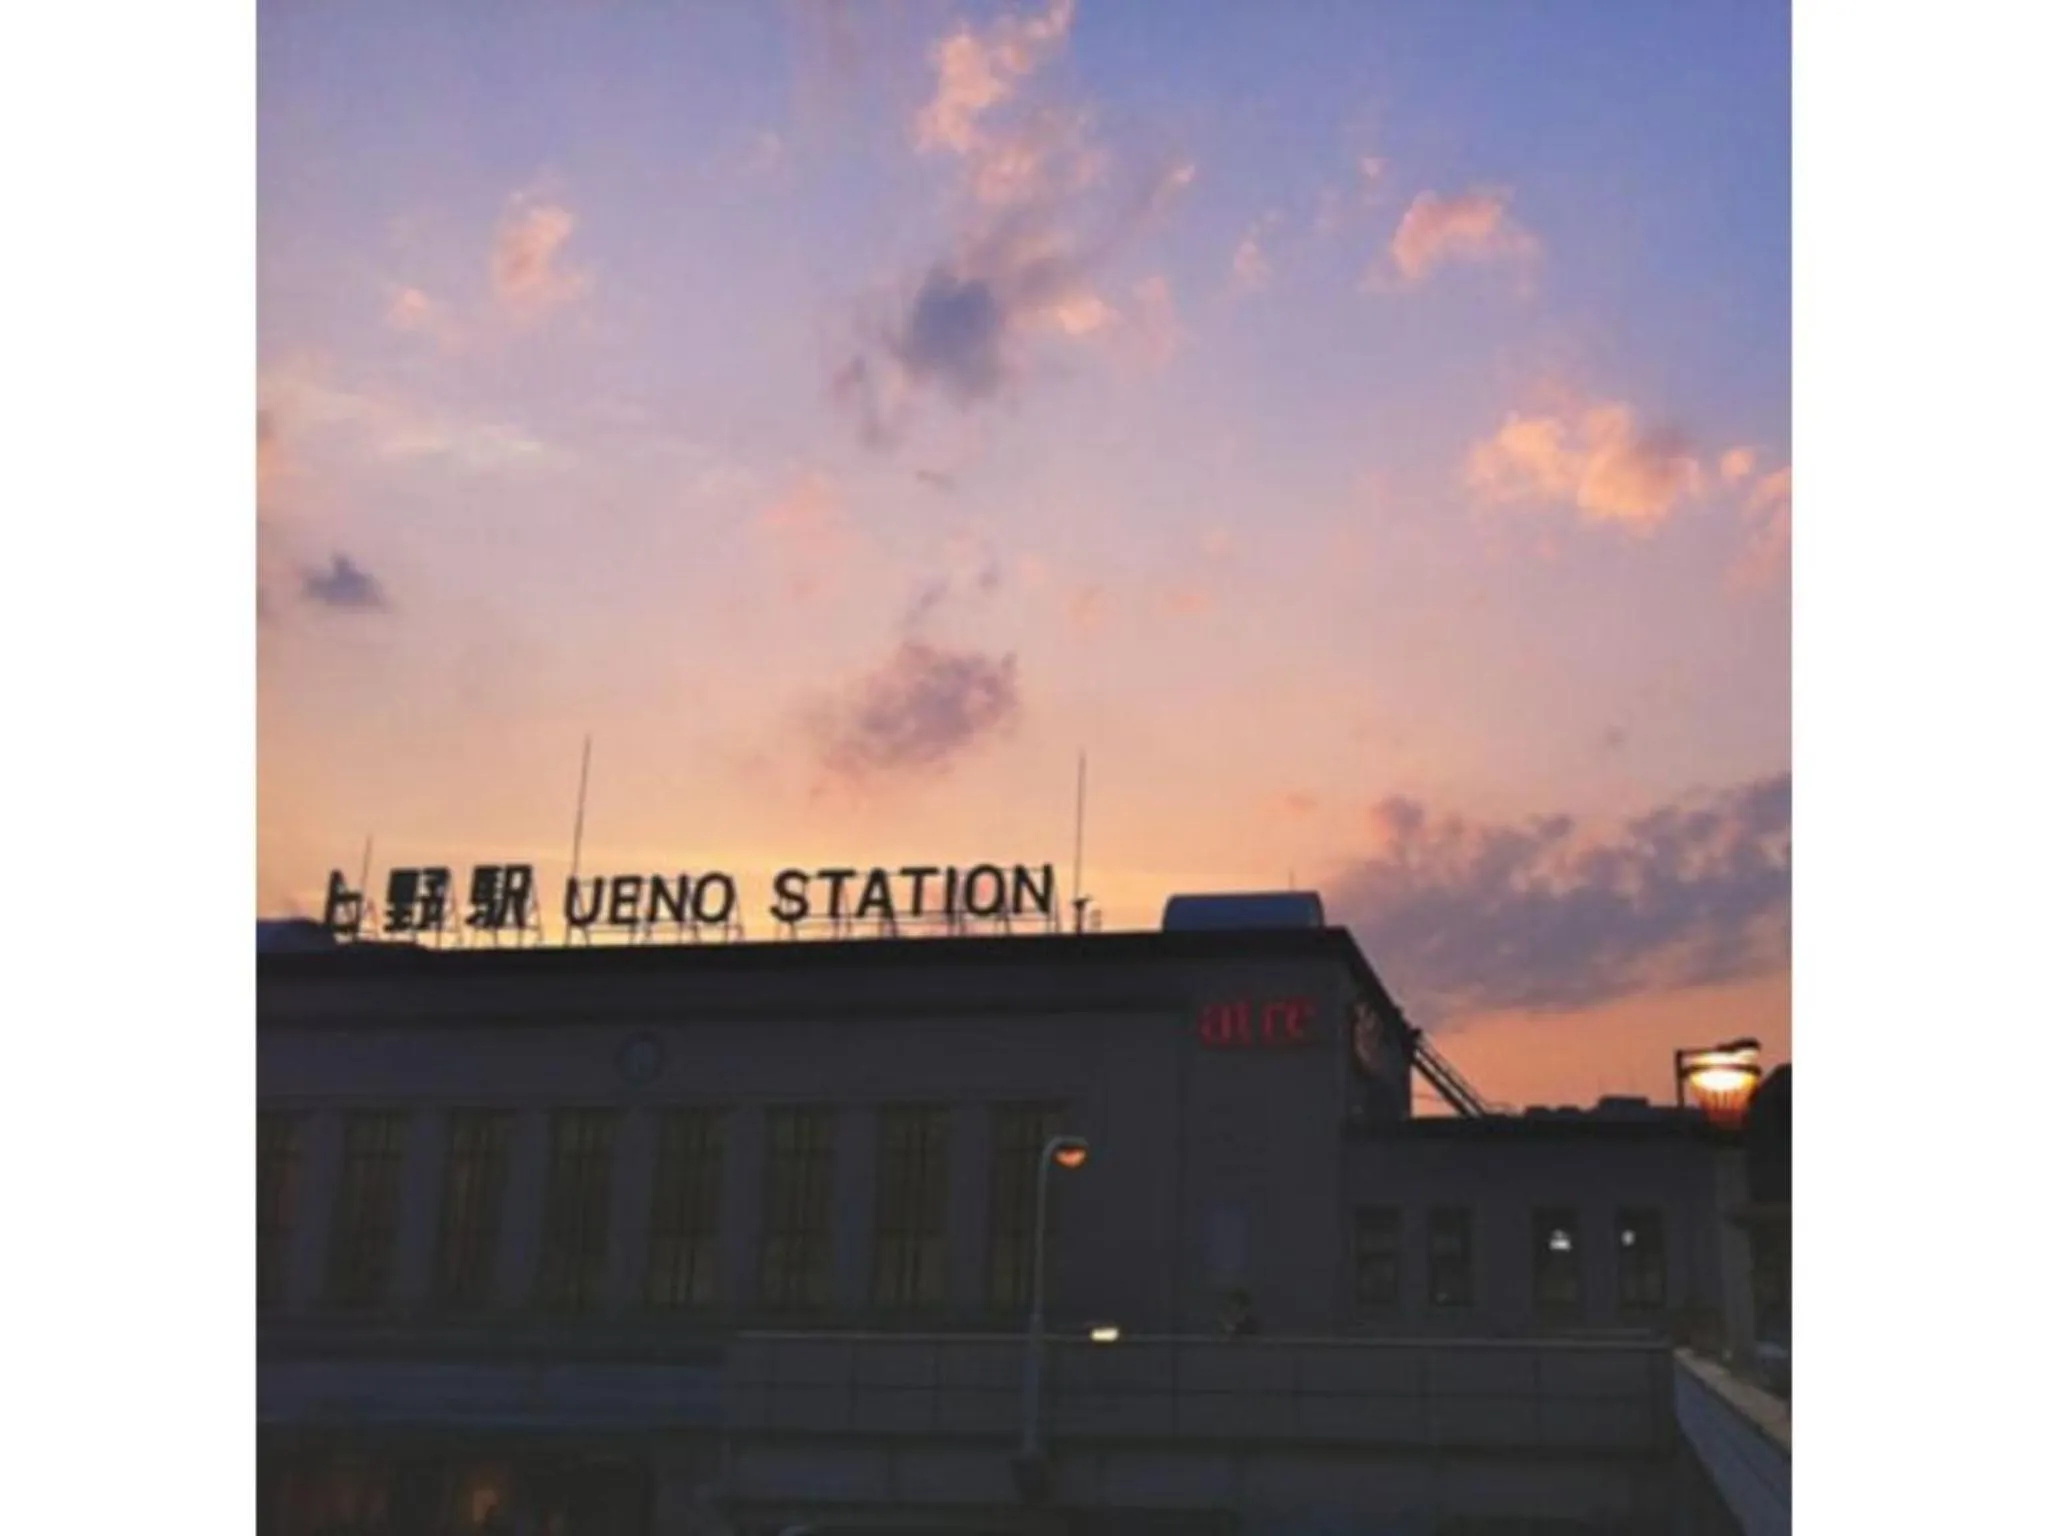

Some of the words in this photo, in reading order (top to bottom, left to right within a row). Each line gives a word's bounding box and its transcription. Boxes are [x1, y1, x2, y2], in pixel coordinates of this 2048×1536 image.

[324, 864, 534, 935] 上野駅
[563, 872, 735, 926] UENO
[769, 862, 1055, 922] STATION
[1198, 993, 1316, 1048] atre
